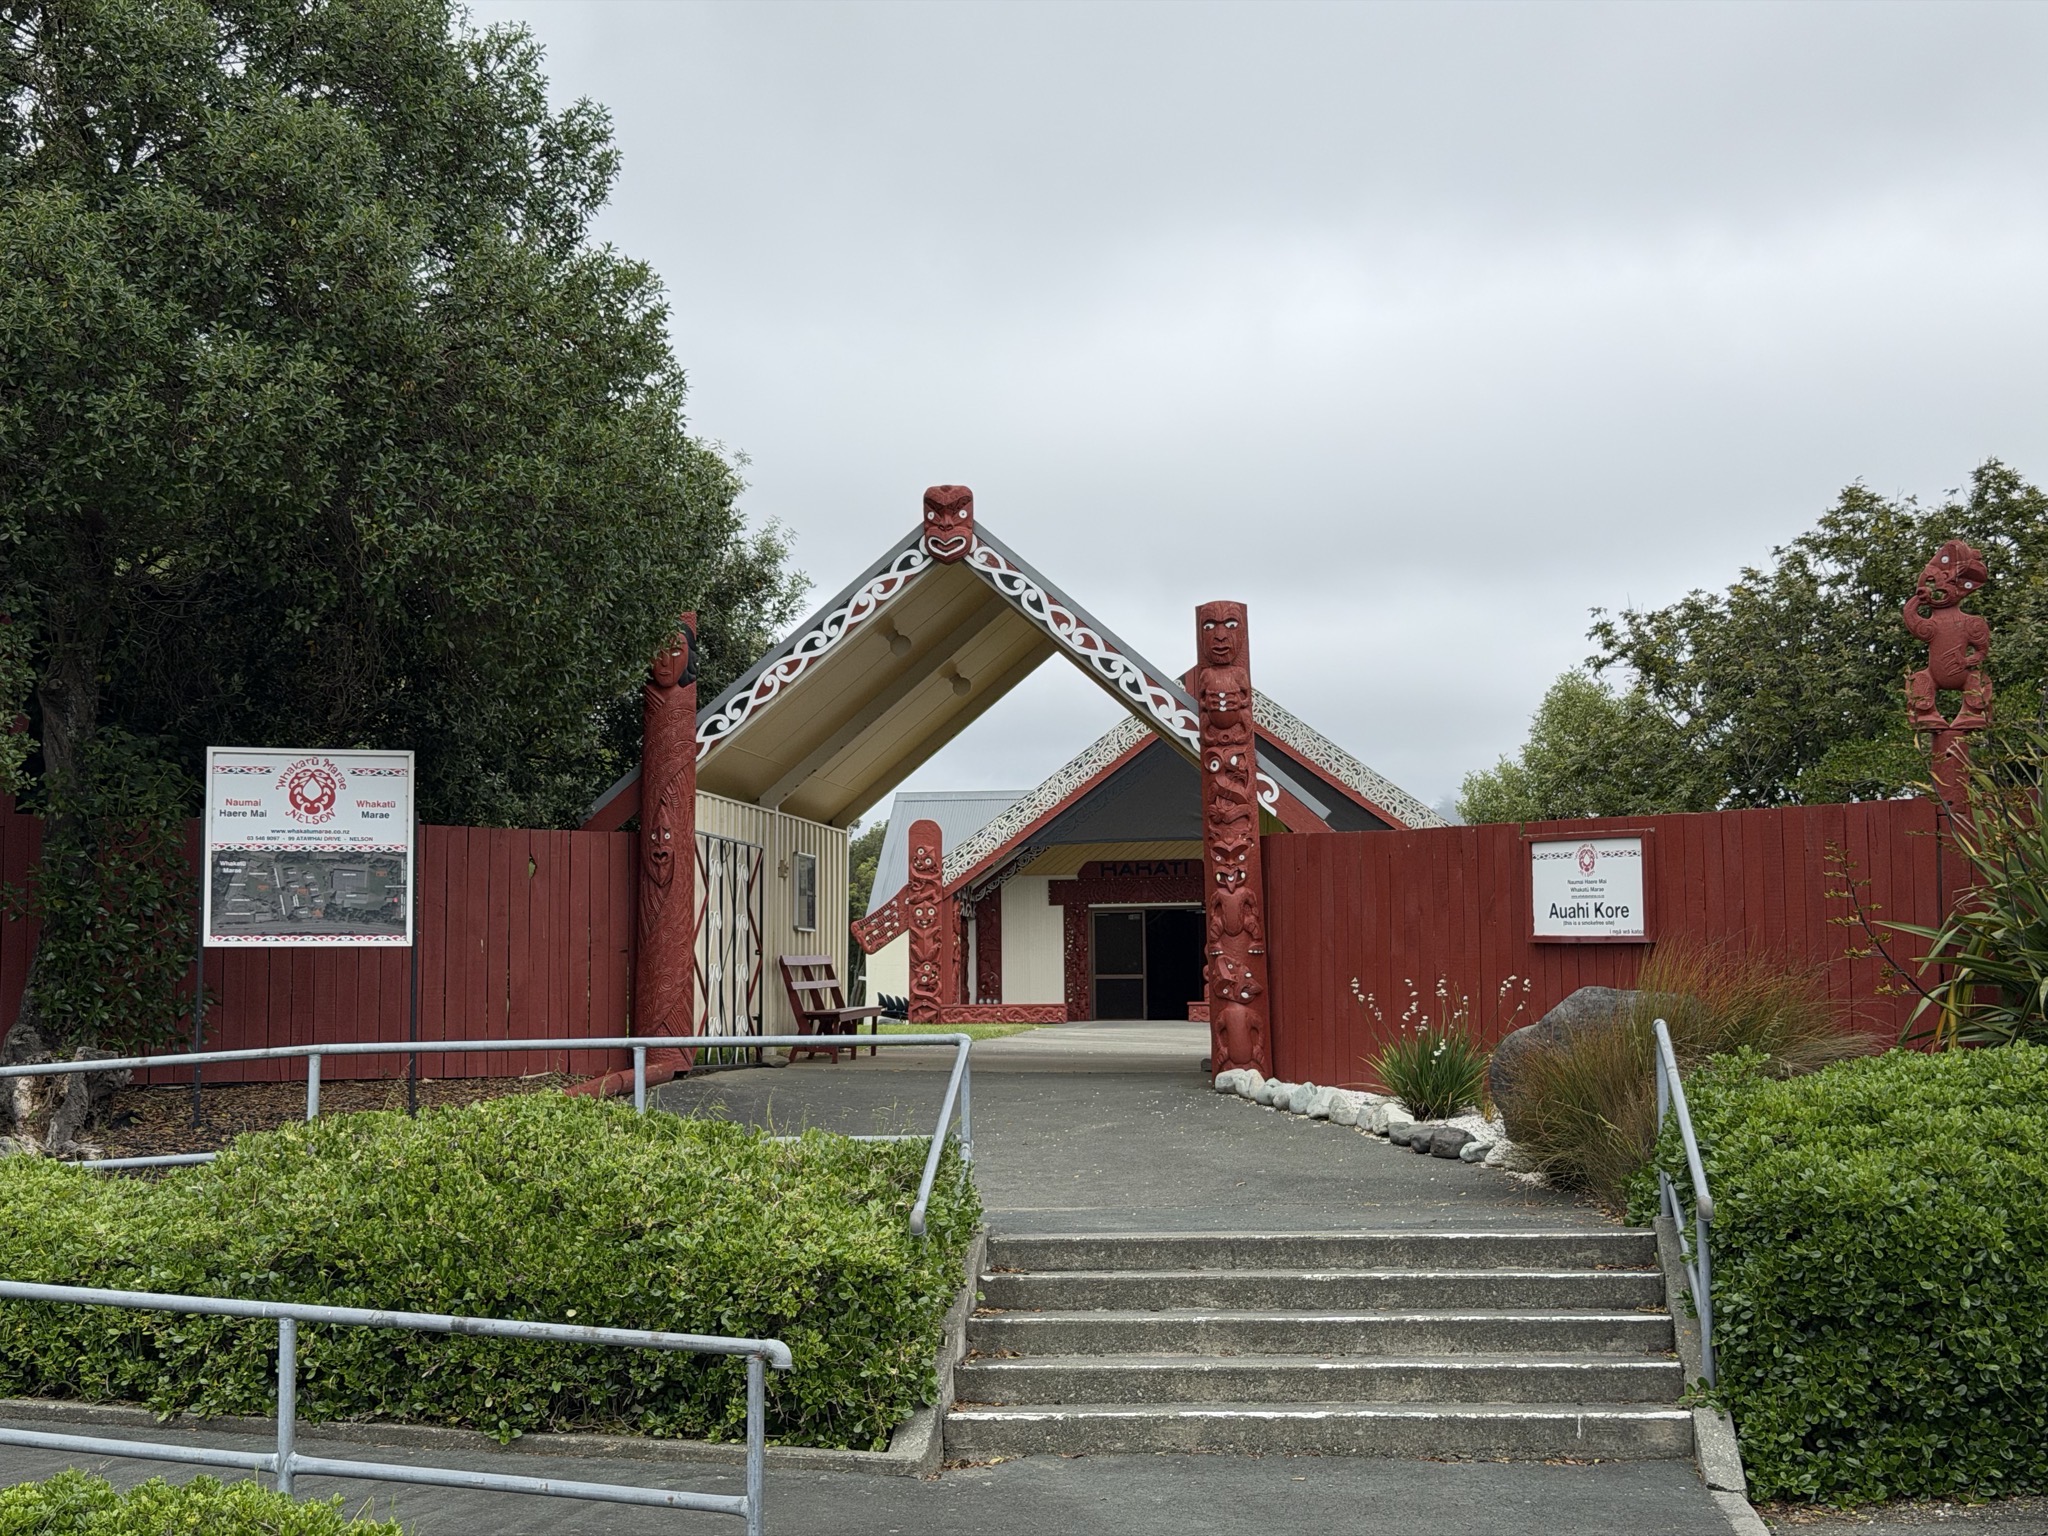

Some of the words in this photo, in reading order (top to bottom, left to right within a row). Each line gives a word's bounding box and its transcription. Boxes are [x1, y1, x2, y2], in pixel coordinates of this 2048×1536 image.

[323, 758, 347, 790] Marae
[225, 798, 261, 807] Naumai
[356, 799, 396, 808] Whakatū
[219, 809, 248, 817] Haere
[250, 809, 267, 818] Mai
[285, 807, 336, 825] NELSON
[361, 811, 390, 819] Marae
[1549, 902, 1589, 919] Auahi
[1594, 902, 1629, 919] Kore
